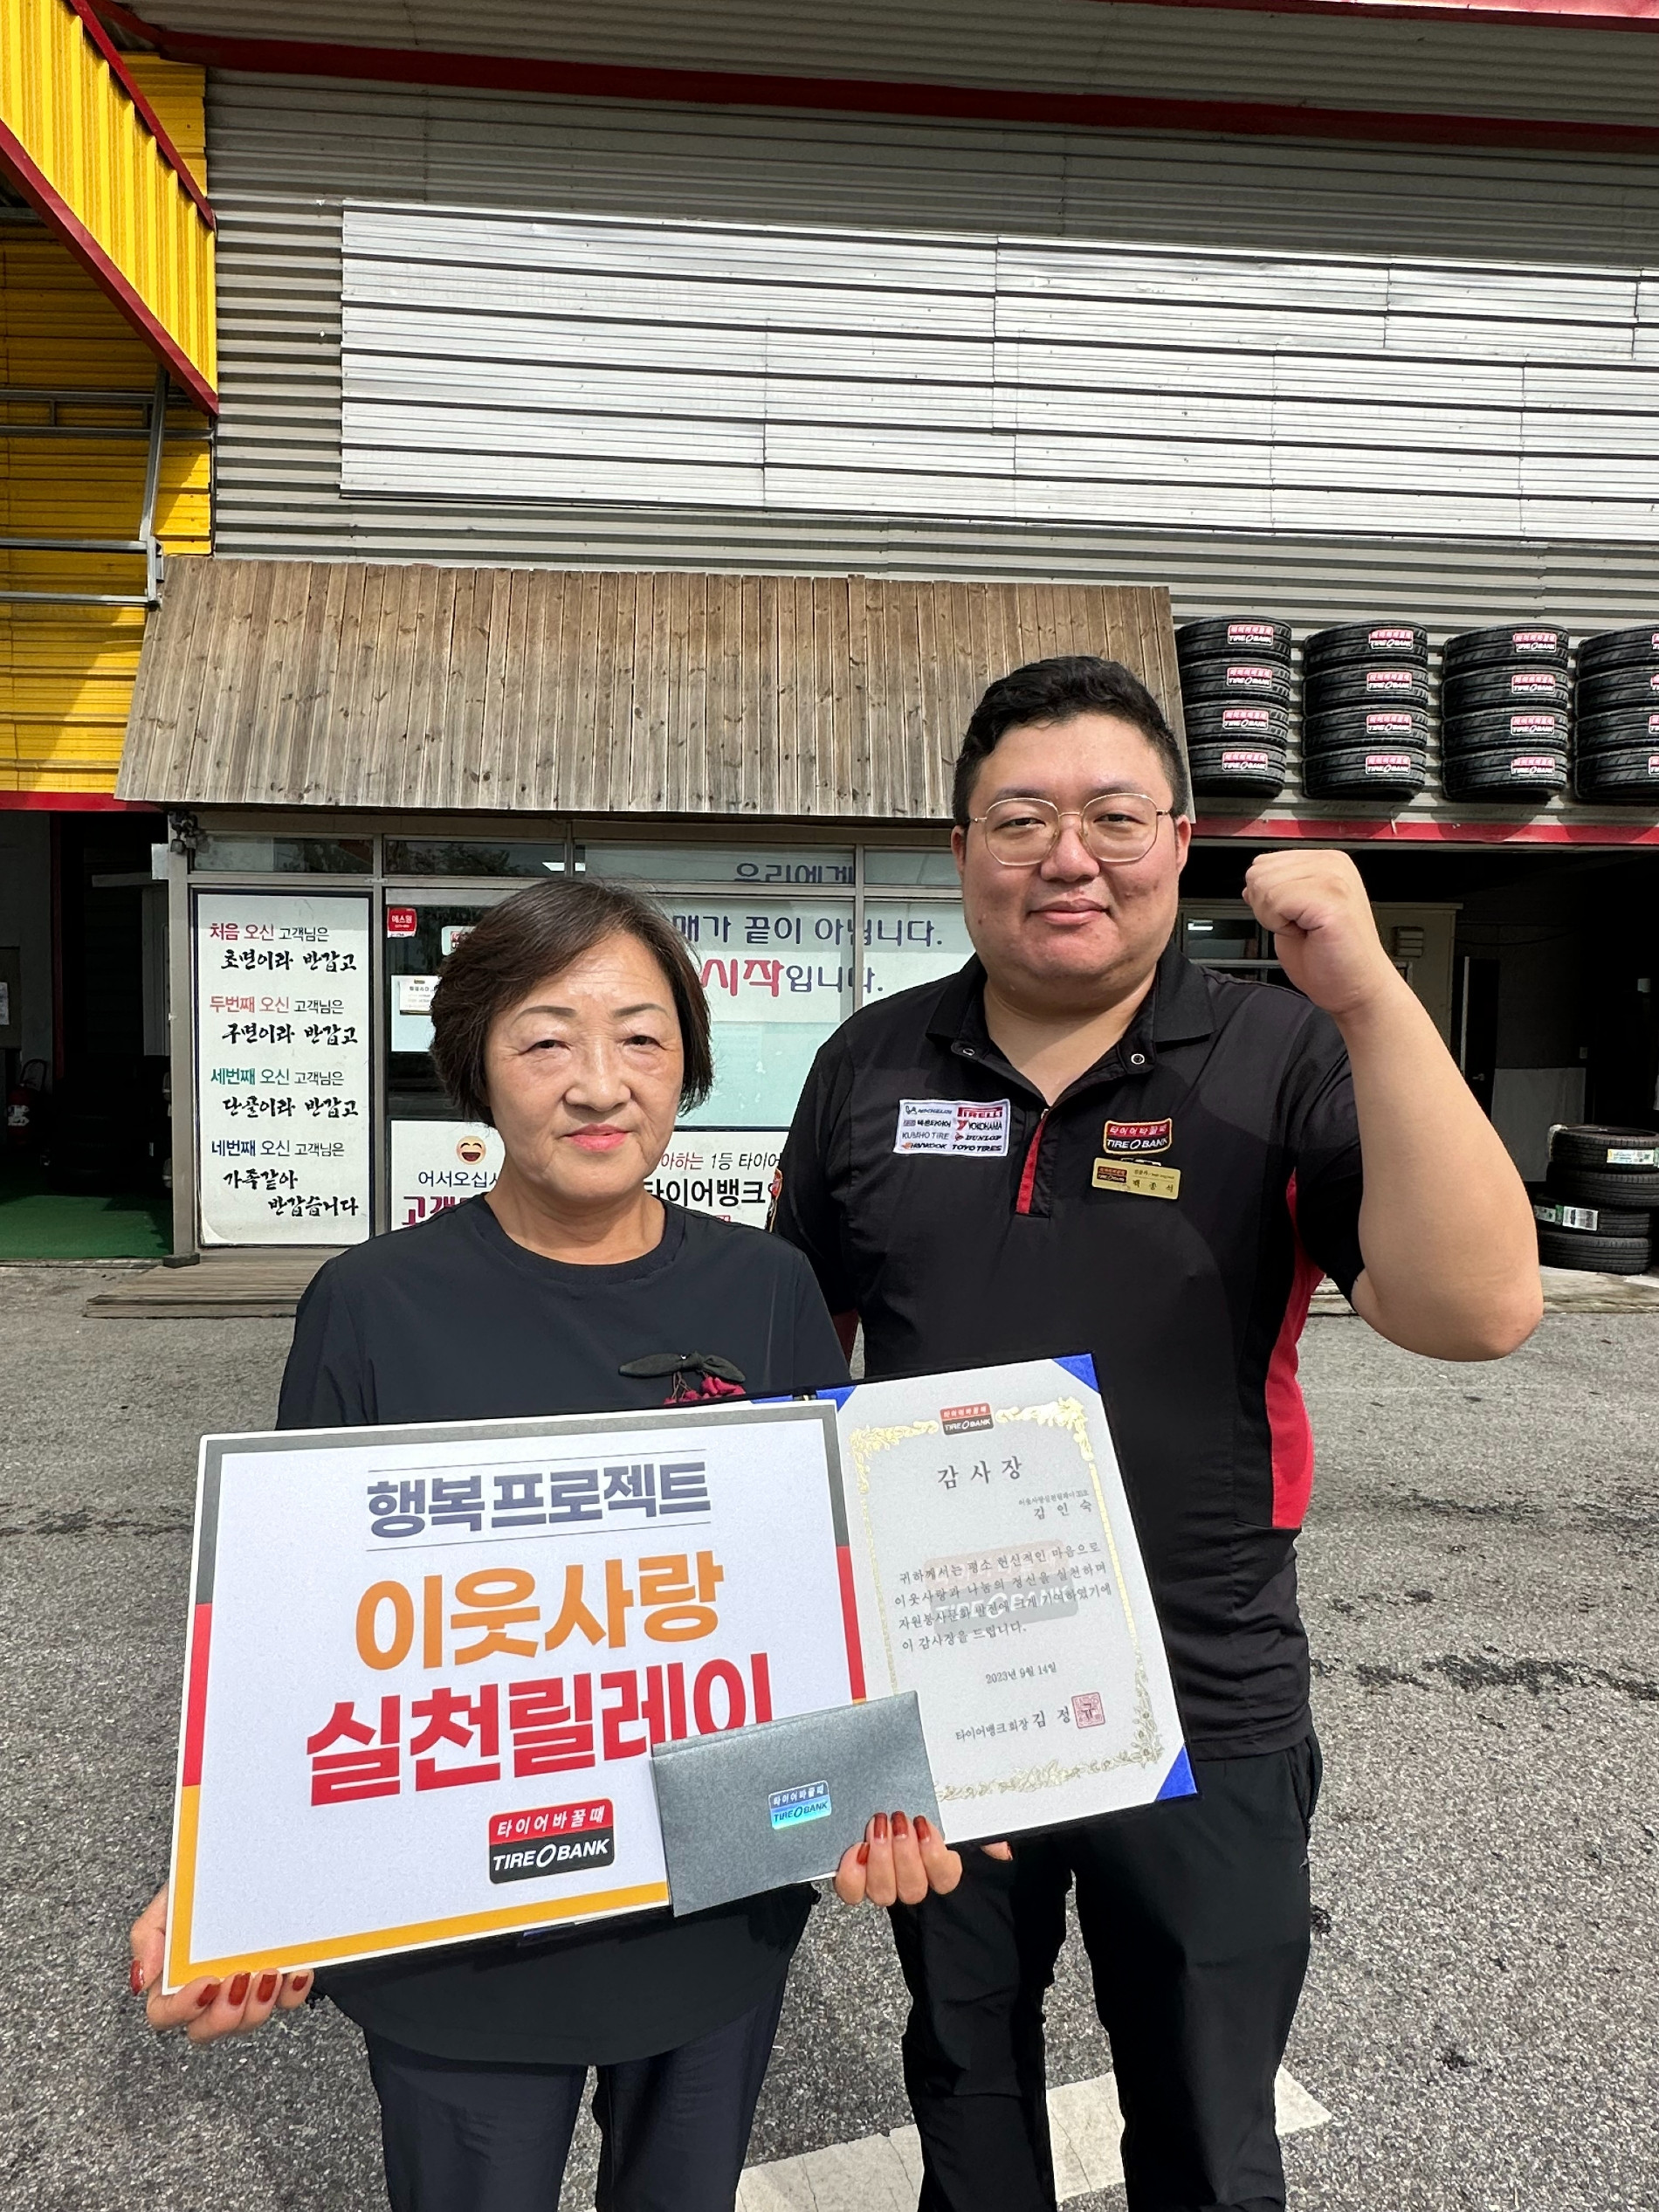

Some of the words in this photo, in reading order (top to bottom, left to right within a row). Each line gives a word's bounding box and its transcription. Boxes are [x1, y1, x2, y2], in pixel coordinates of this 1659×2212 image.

[210, 923, 240, 941] 처음
[244, 923, 274, 941] 오신
[279, 927, 329, 942] 고객님은
[745, 916, 801, 944] 끝이
[221, 948, 293, 971] 초면이라
[302, 950, 357, 973] 반갑고
[210, 996, 255, 1013] 두번째
[259, 996, 289, 1013] 오신
[293, 999, 344, 1015] 고객님은
[222, 1023, 295, 1044] 구면이라
[304, 1023, 358, 1046] 반갑고
[210, 1067, 256, 1085] 세번째
[259, 1068, 290, 1085] 오신
[294, 1071, 344, 1086] 고객님은
[222, 1095, 296, 1118] 단골이라
[305, 1097, 359, 1119] 반갑고
[902, 1131, 930, 1140] KUMHO
[932, 1132, 950, 1140] TIRE
[211, 1139, 256, 1157] 네번째
[259, 1140, 290, 1157] 오신
[294, 1142, 345, 1157] 고객님은
[952, 1143, 976, 1152] TOYO
[711, 1152, 733, 1171] 1등
[223, 1168, 299, 1190] 가족같아
[267, 1196, 359, 1217] 반갑습니다
[899, 1563, 962, 1585] 귀하께서는
[967, 1559, 992, 1575] 평소
[997, 1549, 1047, 1569] 헌신적인
[1051, 1541, 1101, 1560] 마음으로
[894, 1586, 960, 1608] 이웃사랑과
[967, 1578, 1004, 1595] 나눔의
[1012, 1571, 1050, 1589] 정신을
[1057, 1561, 1106, 1581] 실천하며
[355, 1550, 724, 1671] 이웃사랑
[898, 1606, 971, 1630] 자원봉사문화
[1015, 1595, 1037, 1610] 크게
[1043, 1581, 1112, 1609] 기여하였기에
[902, 1639, 913, 1653] 이
[919, 1630, 968, 1650] 감사장을
[973, 1620, 1027, 1640] 드립니다.
[985, 1667, 1018, 1685] 2023년
[1019, 1665, 1035, 1678] 9월
[1037, 1661, 1057, 1676] 14일
[306, 1652, 772, 1808] 실천릴레이
[1008, 1717, 1029, 1733] 회장
